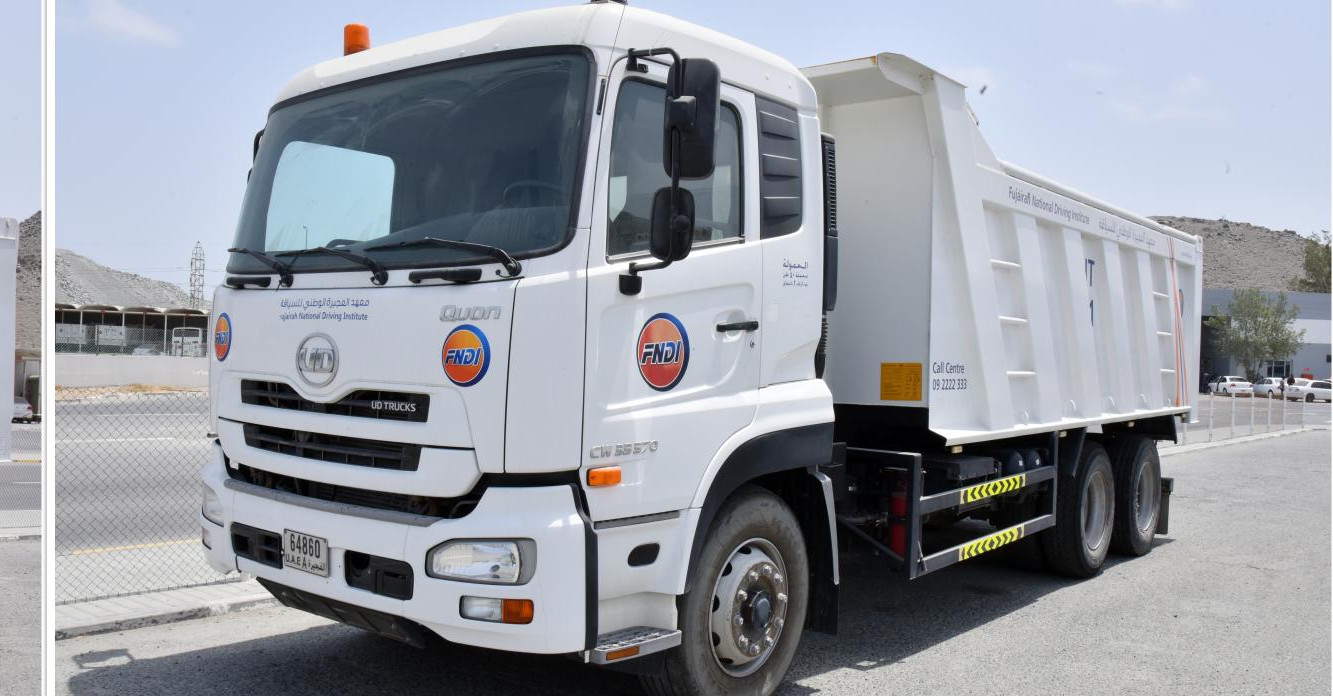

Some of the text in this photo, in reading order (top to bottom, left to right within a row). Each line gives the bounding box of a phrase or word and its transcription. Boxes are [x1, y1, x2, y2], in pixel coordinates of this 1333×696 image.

[1009, 186, 1031, 204] Fujairah
[1032, 195, 1053, 212] National
[322, 312, 342, 322] Driving
[344, 312, 368, 320] Institute
[440, 305, 501, 322] Quon
[445, 348, 482, 366] FNDI
[640, 340, 682, 365] FNDI
[933, 362, 964, 374] Call Centre
[933, 378, 967, 390] 09 2222 333
[372, 401, 416, 412] UD TRUCKS
[290, 534, 320, 558] 64860
